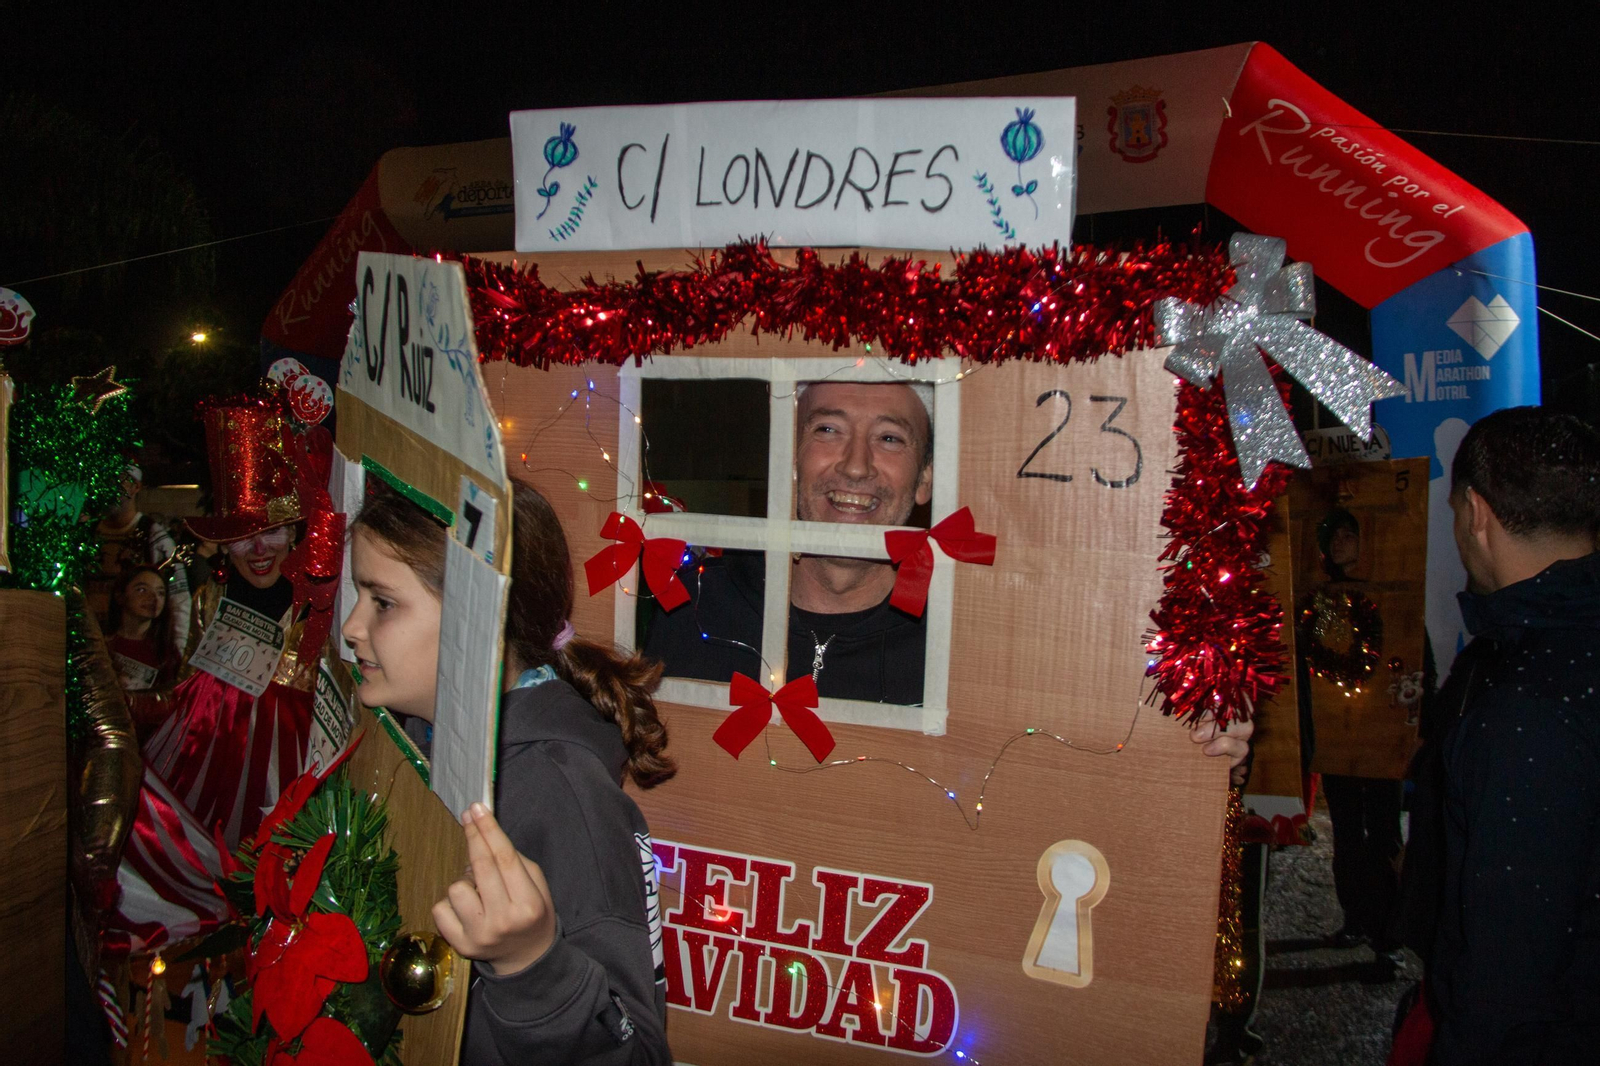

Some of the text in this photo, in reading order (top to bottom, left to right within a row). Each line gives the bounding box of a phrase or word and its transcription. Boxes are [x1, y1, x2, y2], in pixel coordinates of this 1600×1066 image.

[617, 132, 959, 224] C/ LONDRES
[1238, 98, 1447, 269] Running
[1309, 126, 1466, 219] pasión por el
[275, 210, 388, 336] Running
[362, 265, 392, 387] C/
[1016, 389, 1143, 488] 23
[1307, 436, 1323, 457] C/
[1394, 469, 1411, 492] 5
[464, 499, 483, 550] 7
[226, 604, 241, 617] SAN
[242, 622, 252, 632] DE
[252, 626, 272, 640] MOTRIL
[215, 637, 255, 672] 40
